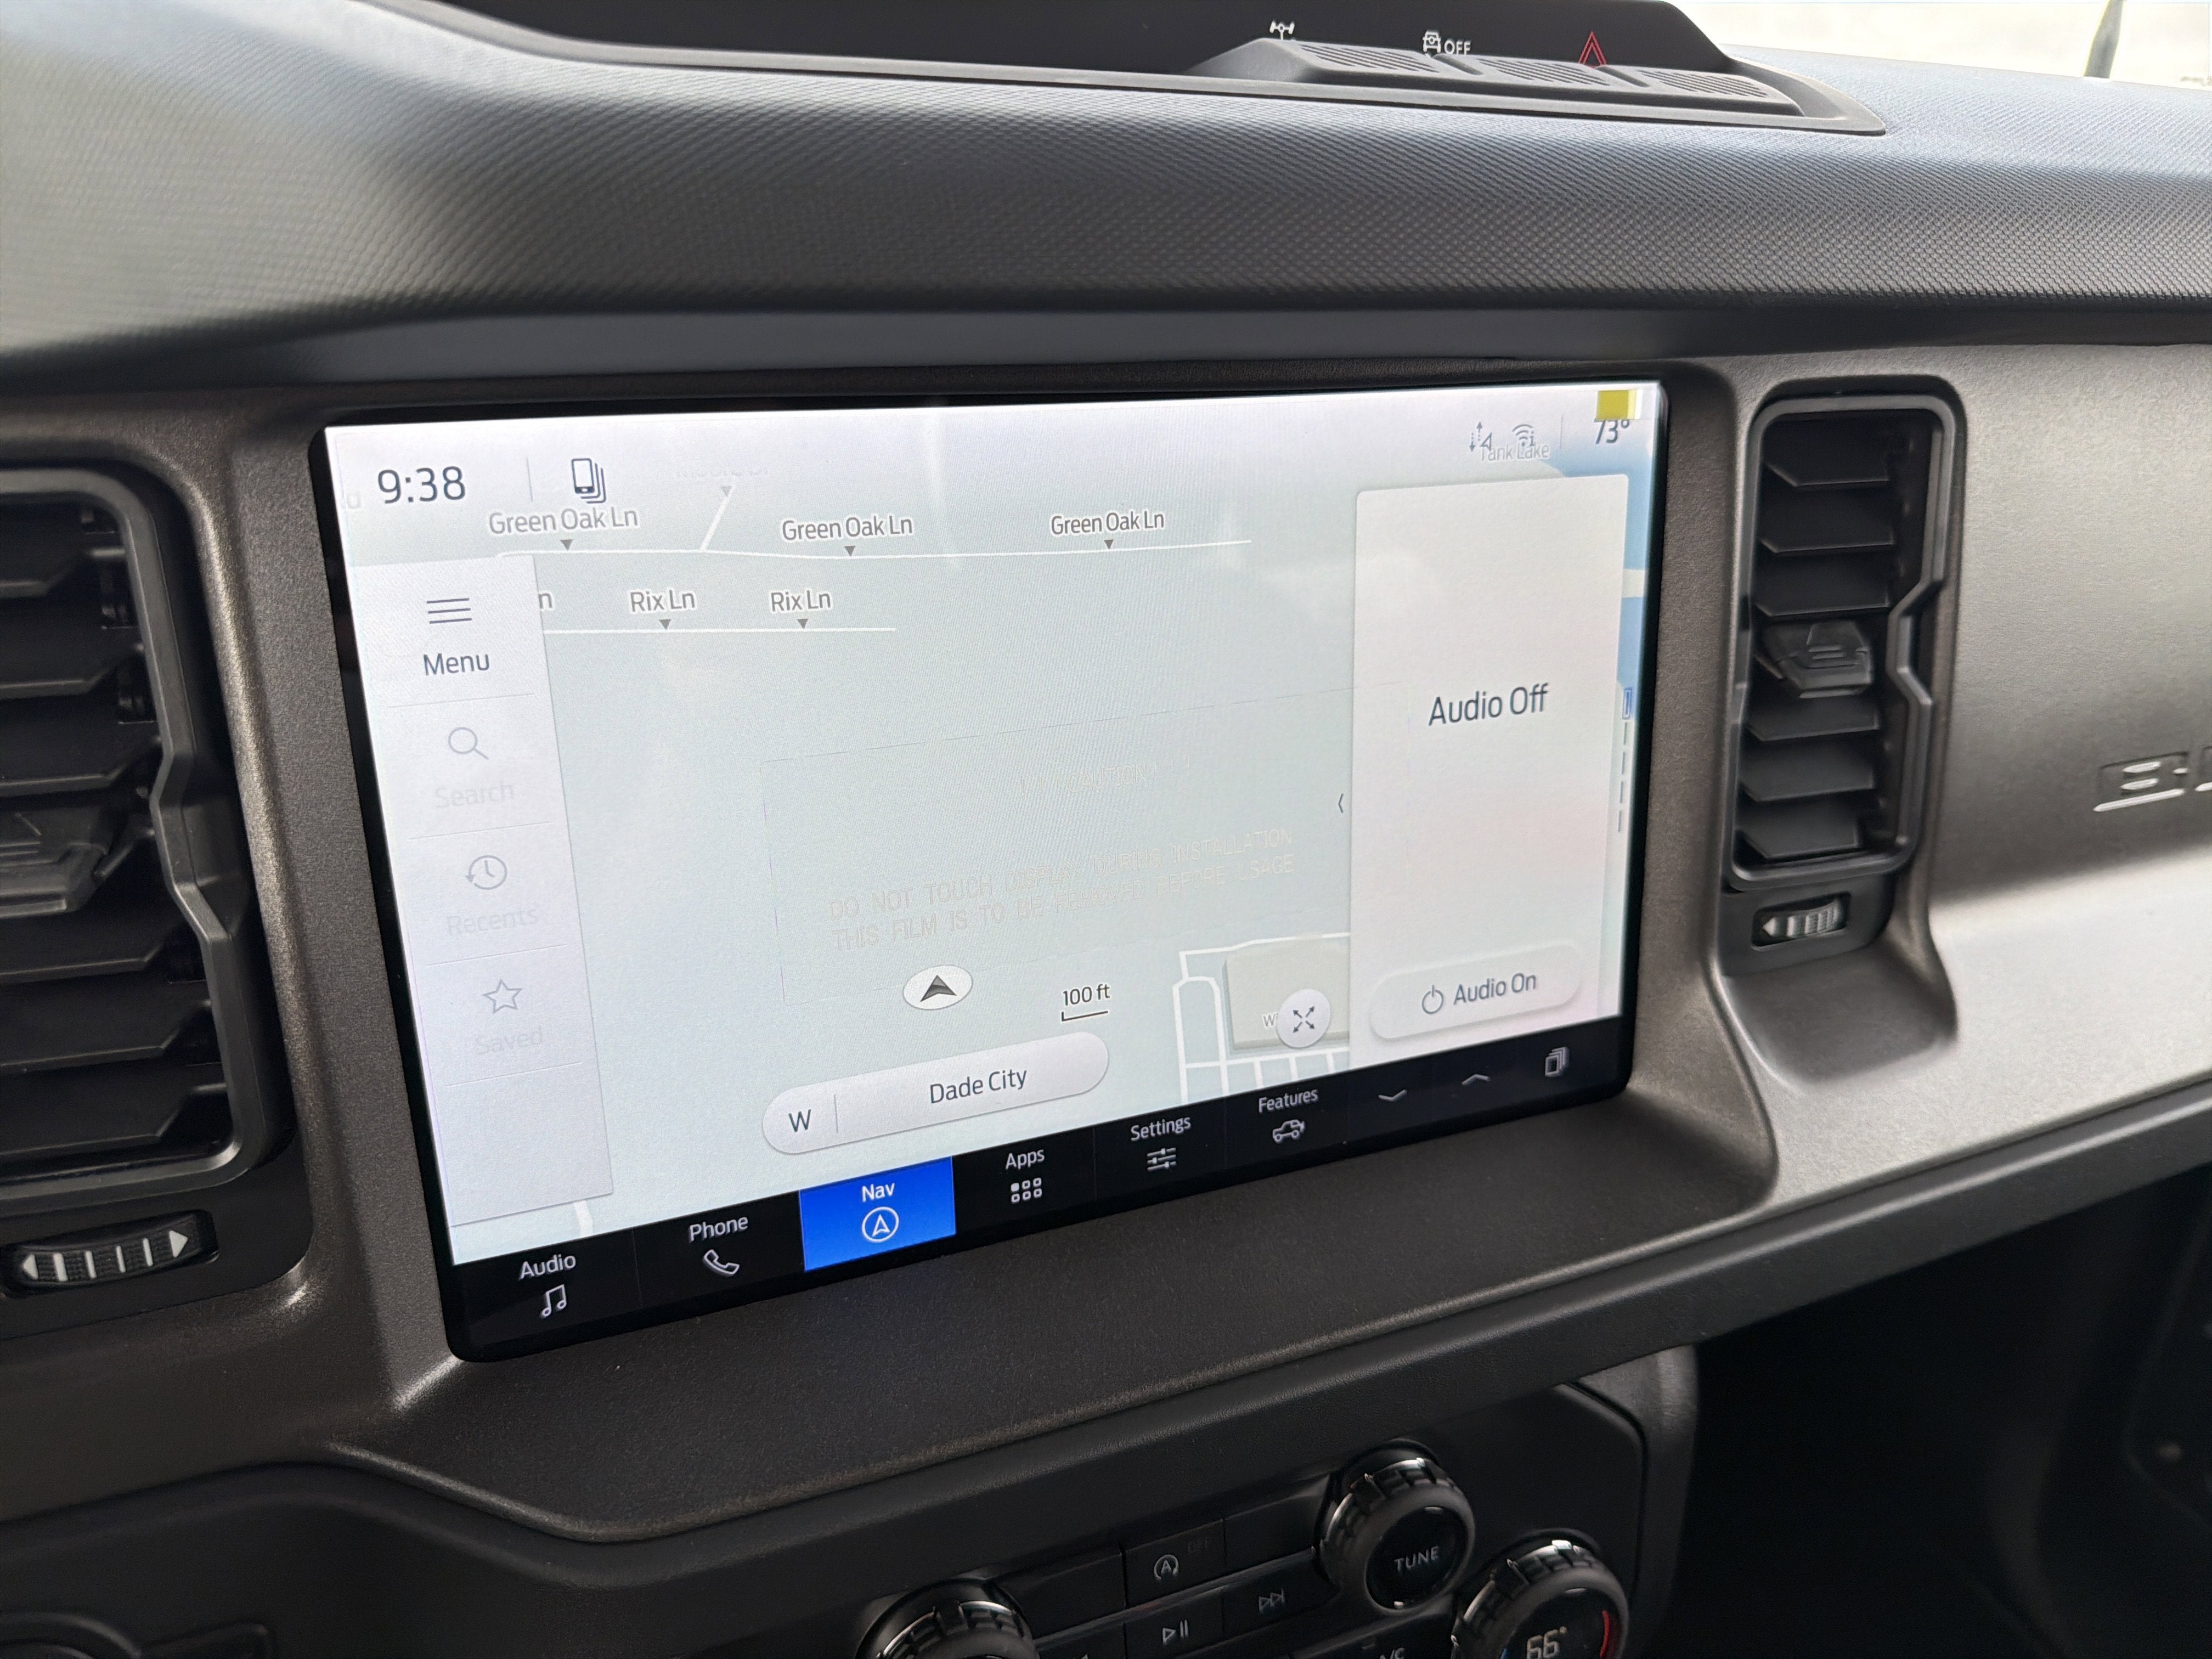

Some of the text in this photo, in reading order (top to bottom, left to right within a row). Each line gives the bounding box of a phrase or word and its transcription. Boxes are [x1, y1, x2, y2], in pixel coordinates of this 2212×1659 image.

[1443, 40, 1471, 55] OFF
[377, 466, 466, 504] 9:38
[488, 507, 639, 534] Green Oak Ln
[782, 515, 913, 540] Green Oak Ln
[1051, 511, 1165, 534] Green Oak Ln
[629, 591, 695, 612] Rix Ln
[770, 590, 831, 612] Rix Ln
[422, 653, 490, 676] Menu
[1429, 683, 1549, 726] Audio Off
[434, 780, 515, 809] Search
[871, 886, 914, 913] NOT
[923, 873, 994, 905] TOUCH
[1172, 827, 1294, 864] INSTALLATION
[447, 905, 540, 937] Recents
[832, 923, 879, 952] THIS
[891, 914, 938, 943] FILM
[1062, 983, 1110, 1006] 100 ft
[1454, 972, 1537, 1005] Audio On
[930, 1068, 1028, 1106] Dade City
[1257, 1087, 1318, 1114] Features
[789, 1109, 813, 1132] W
[1130, 1116, 1192, 1142] Settings
[1004, 1148, 1046, 1172] Apps
[860, 1181, 895, 1201] Nav
[688, 1215, 748, 1243] Phone
[519, 1252, 576, 1279] Audio
[1394, 1545, 1441, 1573] TUNE
